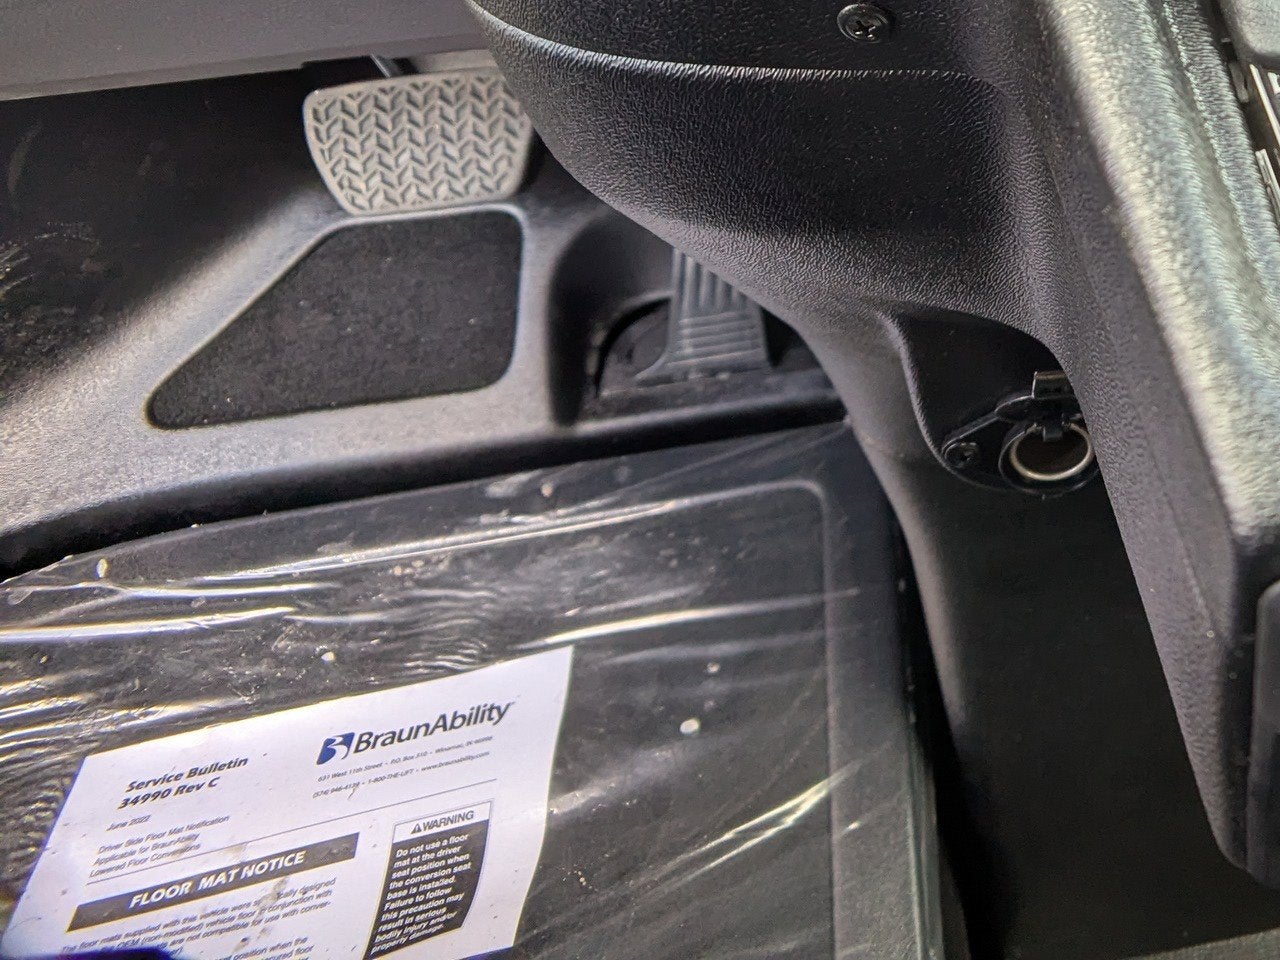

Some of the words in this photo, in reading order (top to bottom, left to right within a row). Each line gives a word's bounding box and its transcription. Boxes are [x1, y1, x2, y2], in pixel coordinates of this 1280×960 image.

[353, 702, 511, 754] BraunAbility
[125, 772, 184, 793] Service
[185, 757, 249, 779] Bulletin
[117, 787, 173, 810] 34990
[173, 782, 205, 796] Rev
[208, 776, 221, 787] C
[422, 810, 474, 832] WARNING
[145, 831, 167, 842] Floor
[167, 826, 185, 836] Mat
[396, 849, 409, 858] Do
[409, 844, 424, 855] not
[425, 841, 441, 850] use
[449, 834, 469, 844] floor
[391, 868, 410, 879] seat
[410, 859, 446, 875] position
[447, 853, 470, 865] when
[393, 858, 411, 869] mat
[411, 856, 421, 864] at
[421, 852, 435, 861] the
[436, 846, 462, 857] driver
[128, 880, 193, 909] FLOOR
[197, 868, 240, 890] MAT
[240, 850, 307, 880] NOTICE
[389, 880, 404, 890] the
[404, 867, 452, 886] conversion
[452, 862, 472, 873] seat
[381, 911, 399, 921] this
[398, 899, 445, 918] precaution
[446, 892, 465, 904] may
[383, 897, 415, 911] Failure
[415, 894, 425, 902] to
[425, 887, 453, 900] follow
[386, 889, 408, 900] base
[377, 918, 404, 932] result
[404, 916, 415, 925] in
[414, 907, 447, 922] serious
